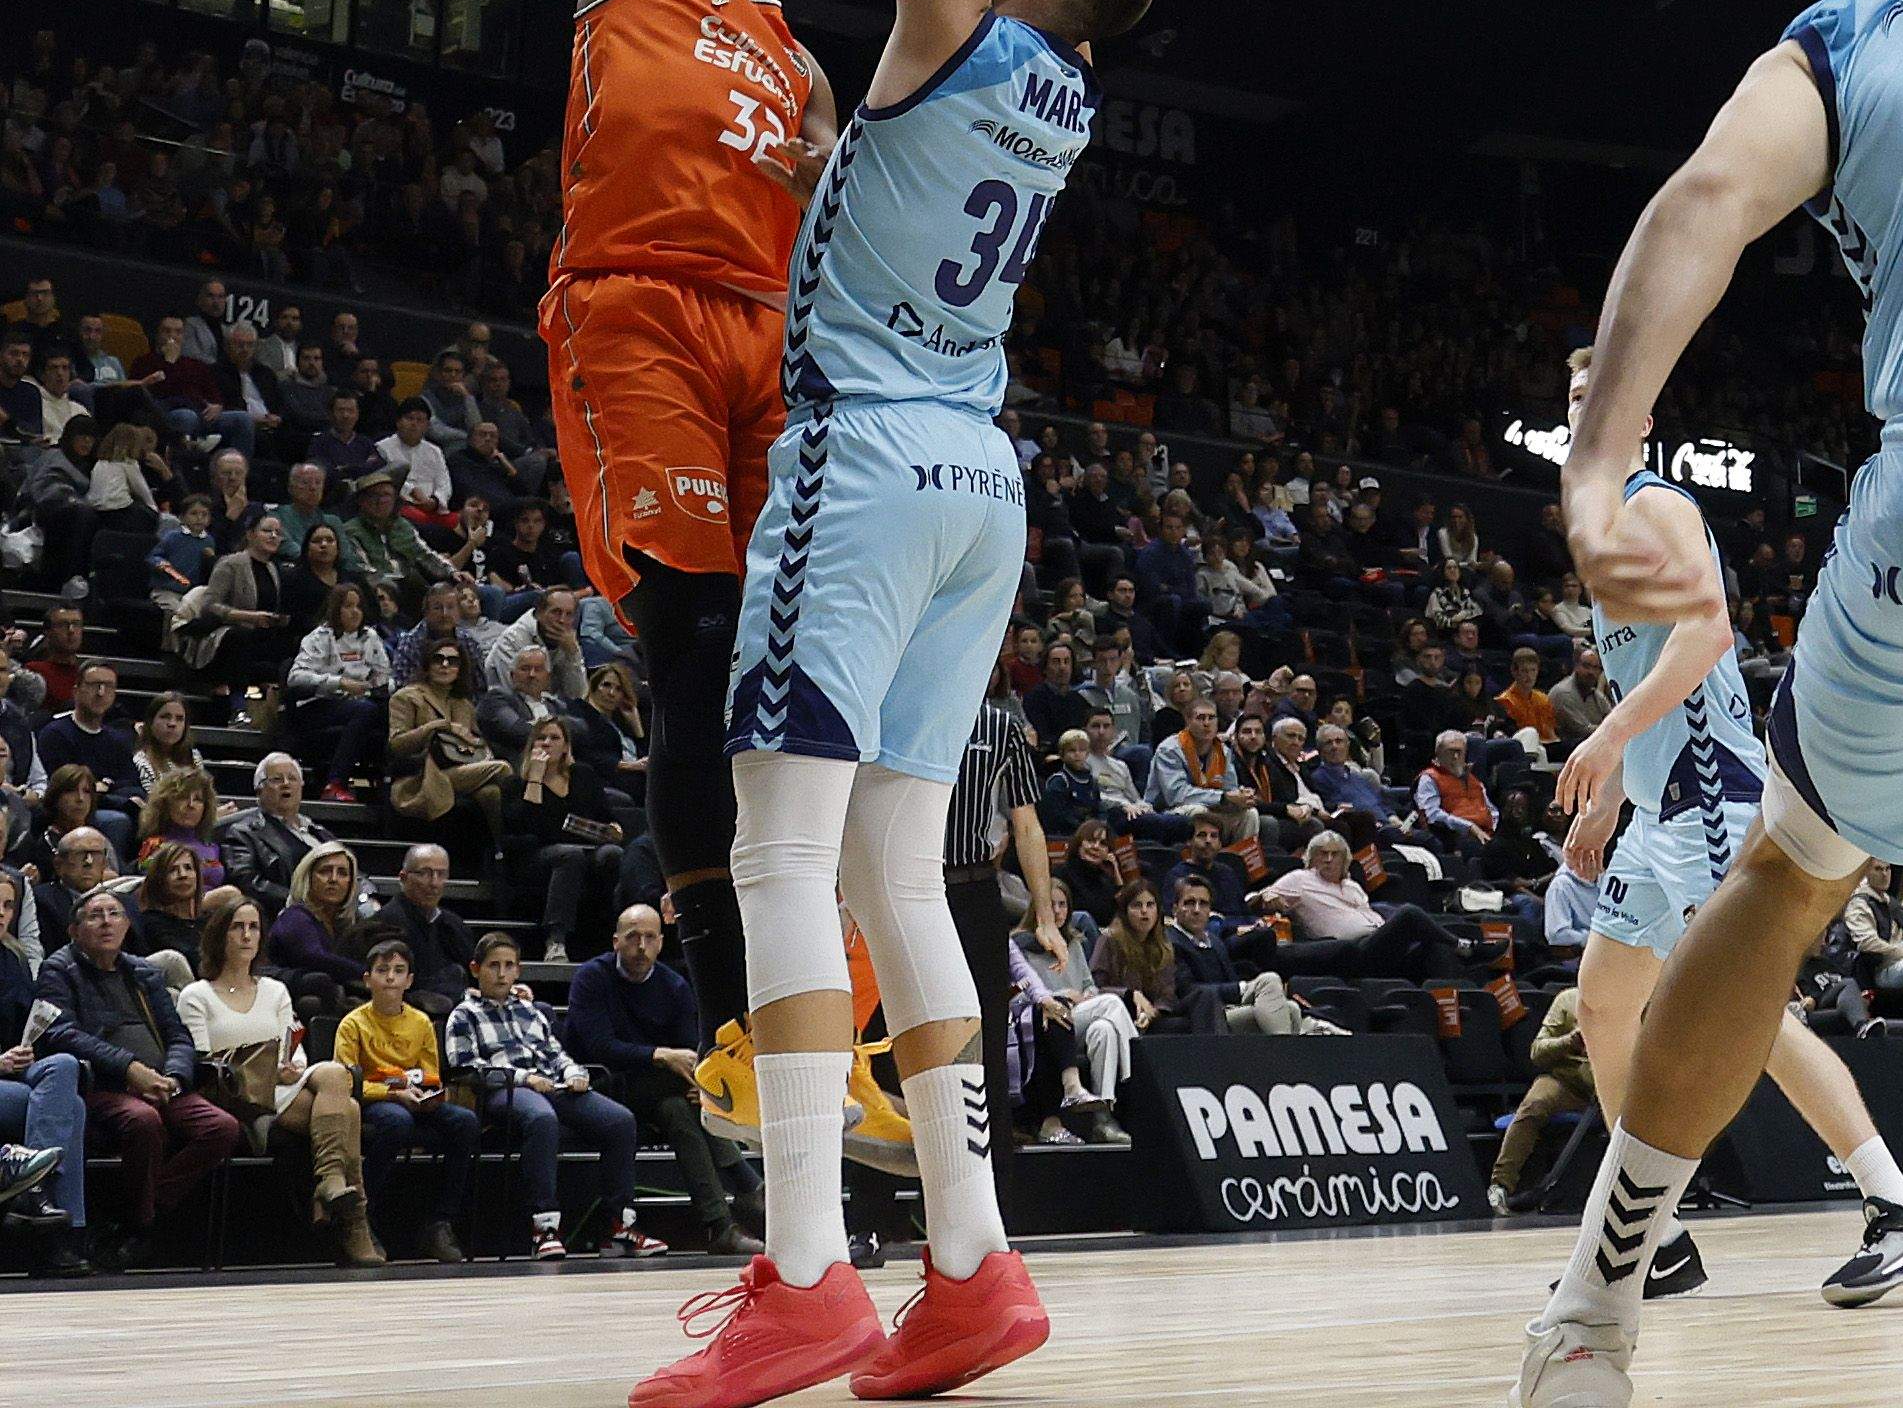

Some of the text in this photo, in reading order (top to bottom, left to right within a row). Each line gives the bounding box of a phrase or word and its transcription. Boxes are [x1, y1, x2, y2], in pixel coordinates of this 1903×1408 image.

[717, 89, 795, 177] 32
[1018, 71, 1086, 134] MAR
[225, 293, 270, 329] 124
[1176, 1081, 1449, 1160] PAMESA
[1220, 1163, 1460, 1222] cerámica
